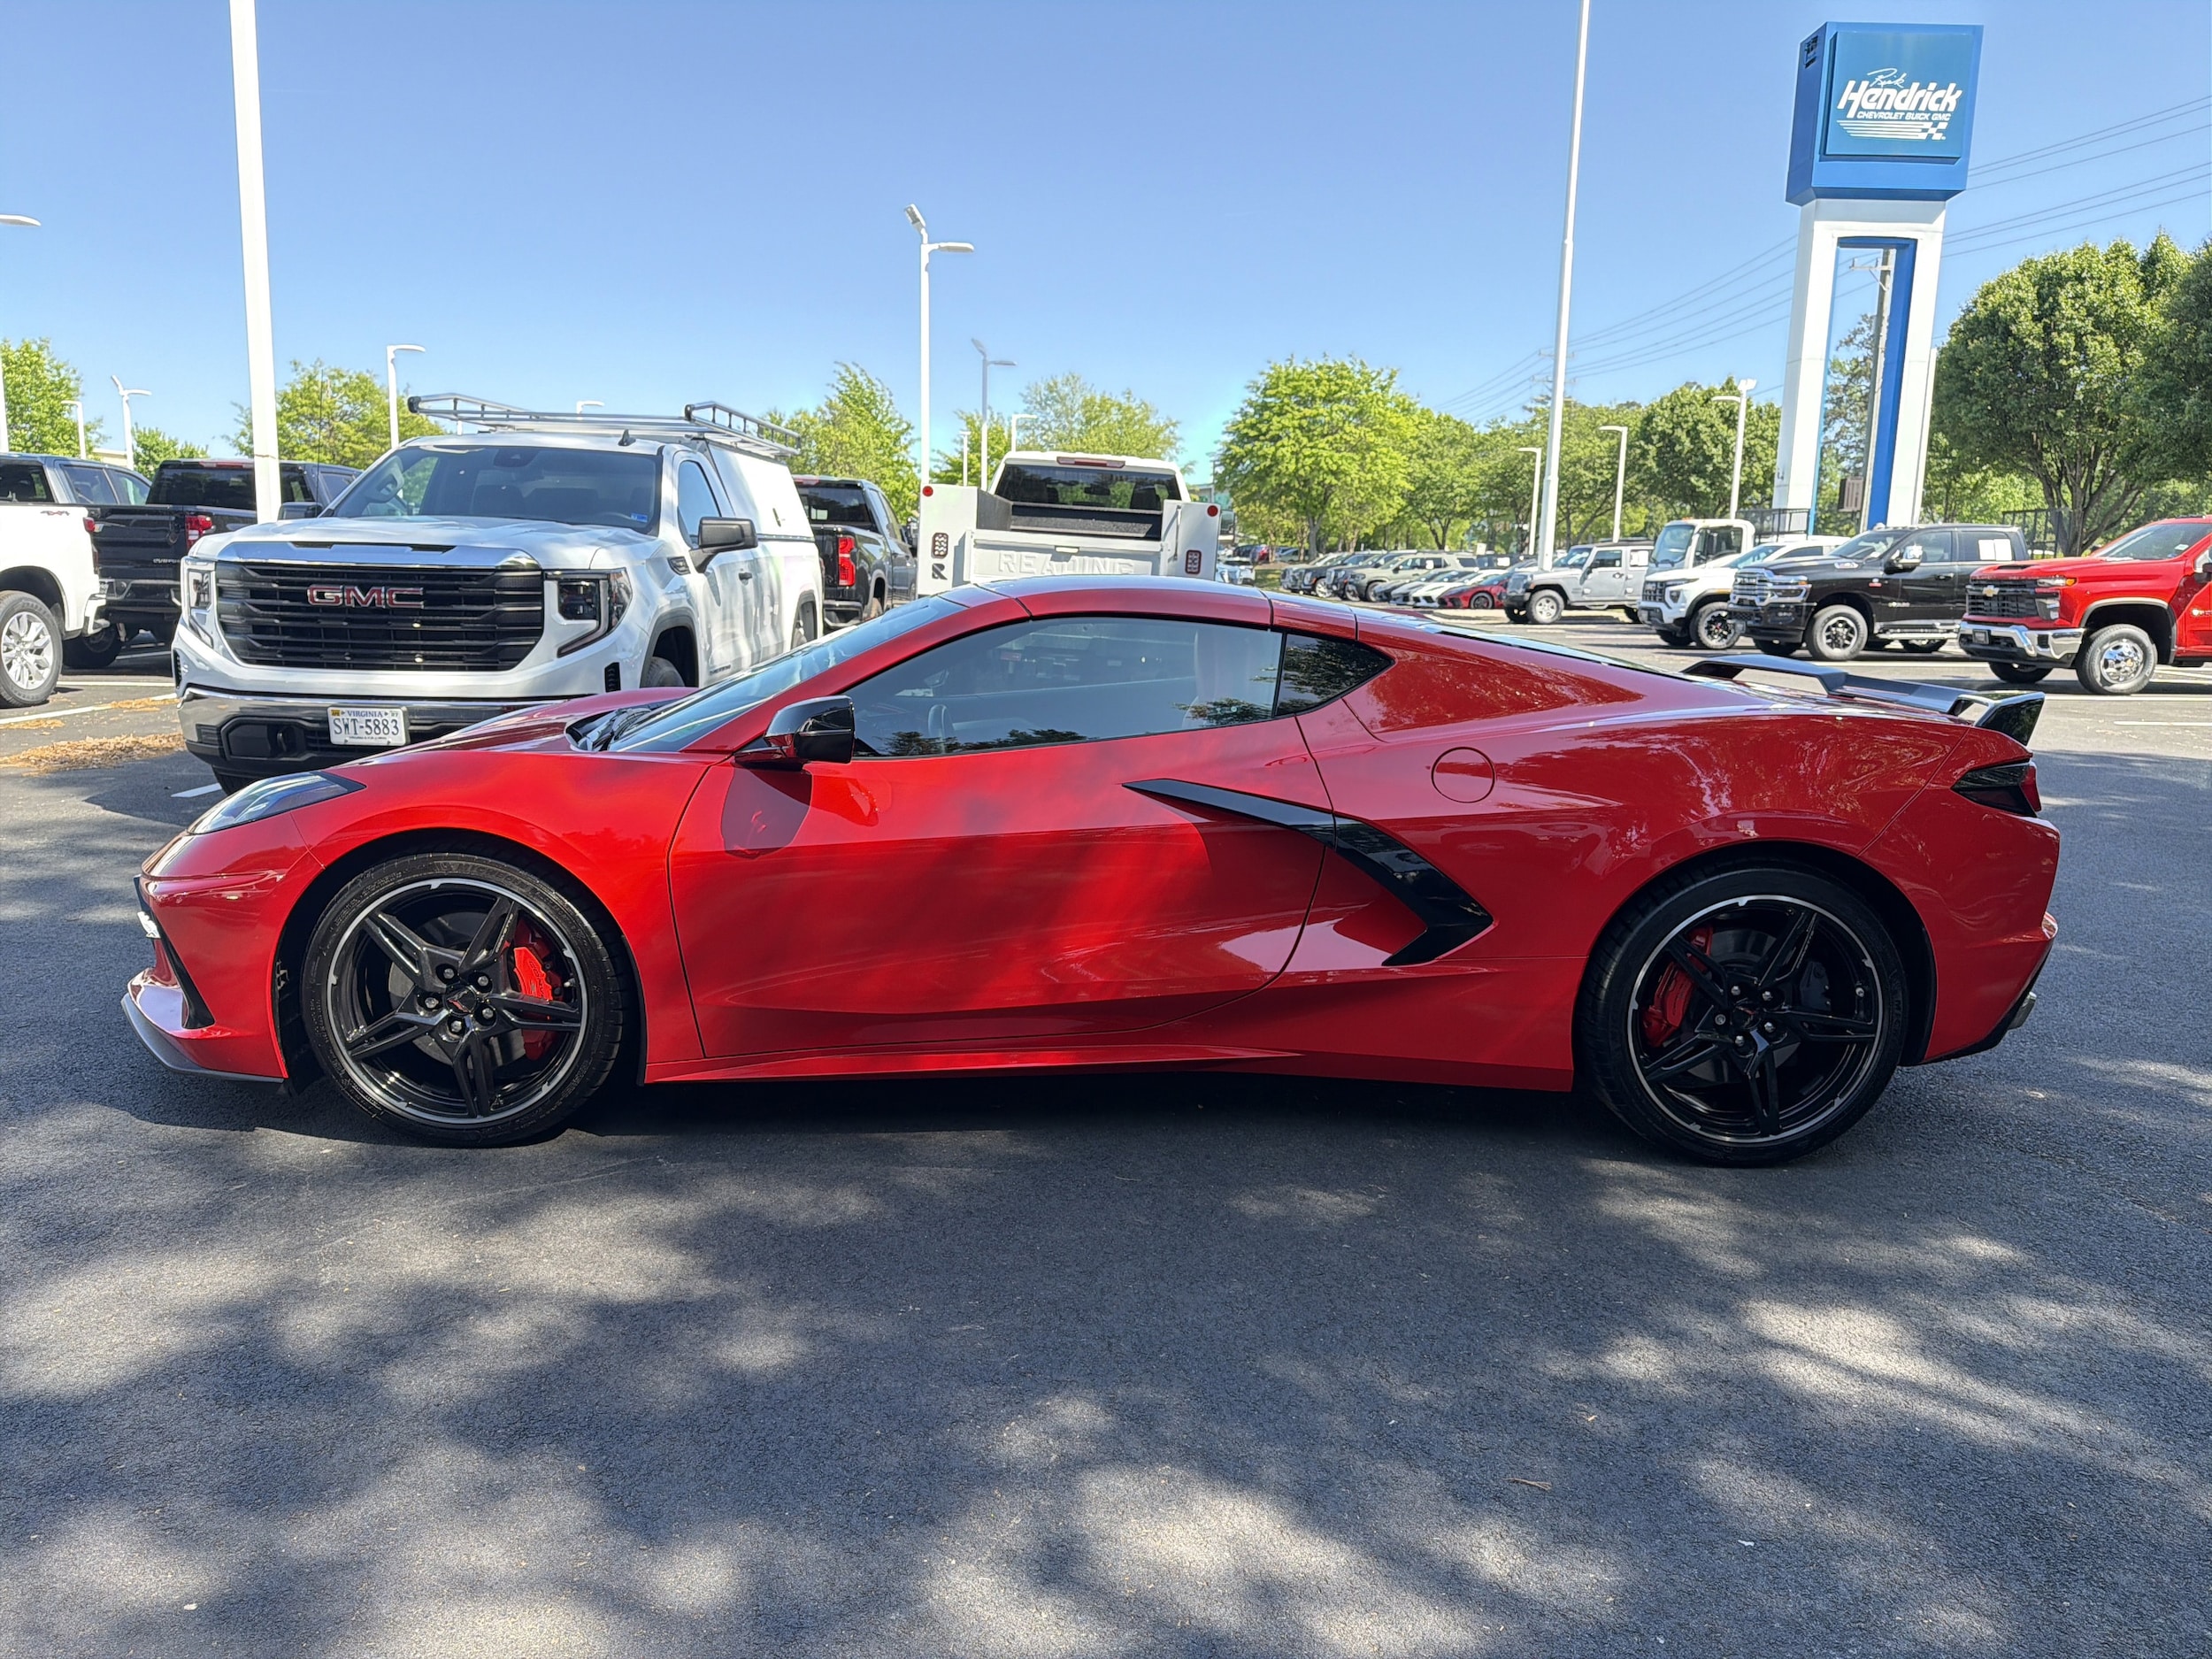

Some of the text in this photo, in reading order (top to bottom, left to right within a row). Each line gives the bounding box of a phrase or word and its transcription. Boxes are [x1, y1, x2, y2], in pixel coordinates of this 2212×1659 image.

[1837, 80, 1962, 119] Hendrick
[1856, 111, 1952, 121] CHEVROLET BUICK GMC
[307, 584, 424, 609] GMC
[333, 718, 399, 736] SWT-5883
